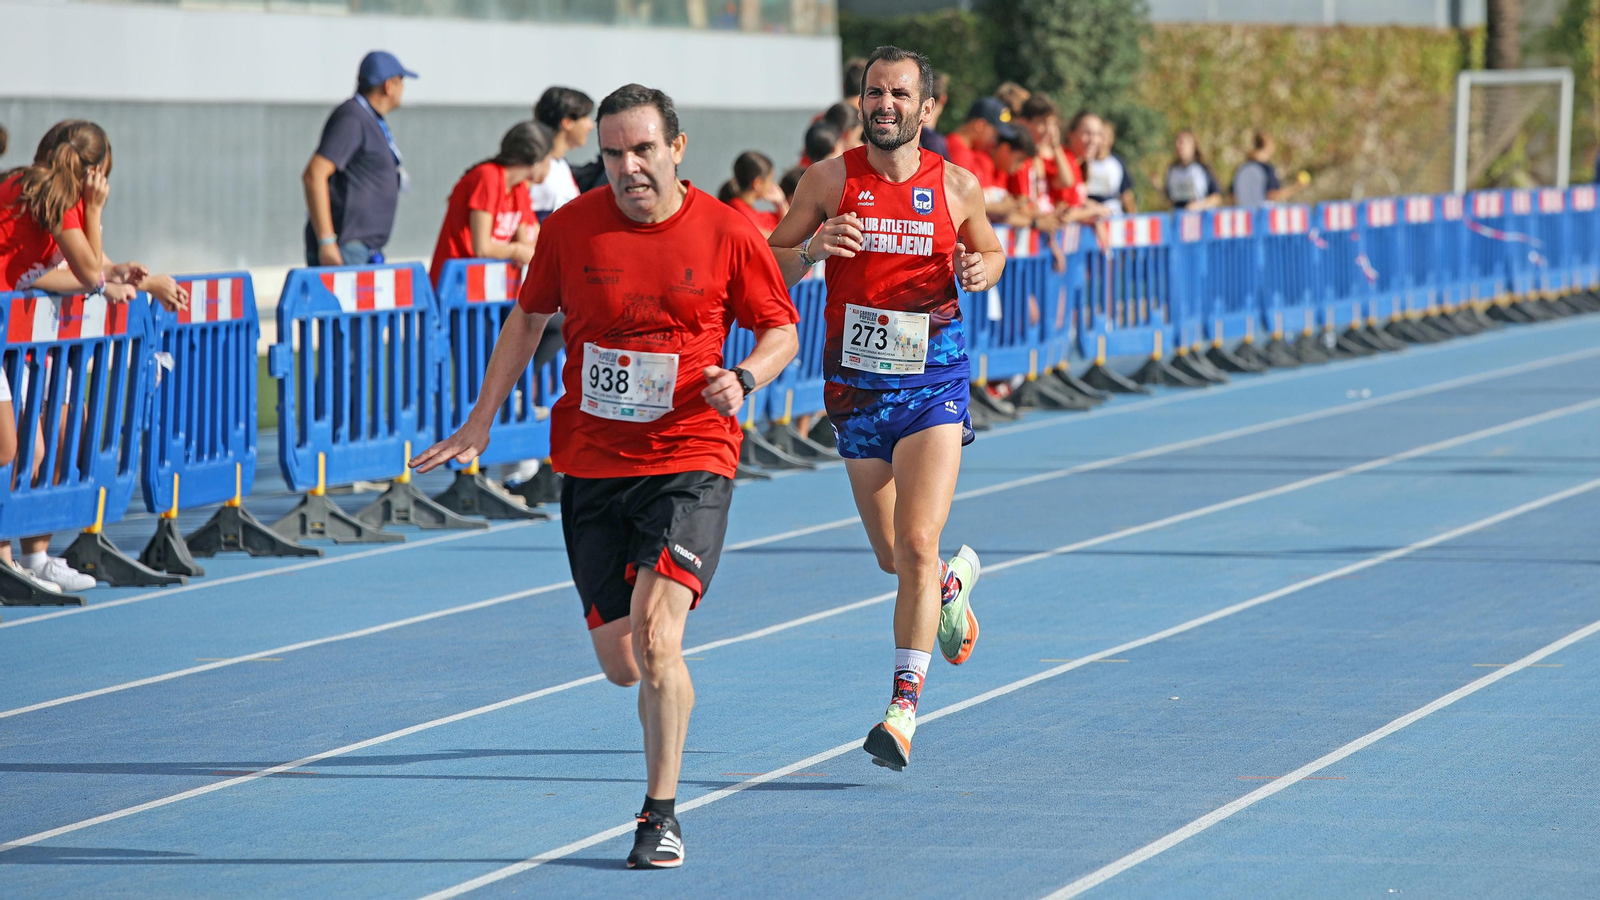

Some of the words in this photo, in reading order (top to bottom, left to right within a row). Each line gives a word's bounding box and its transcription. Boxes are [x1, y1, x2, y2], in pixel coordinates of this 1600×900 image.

[858, 218, 879, 232] LUB
[880, 218, 934, 236] ATLETISMO
[861, 233, 933, 256] REBUJENA
[851, 323, 888, 350] 273
[590, 364, 629, 394] 938
